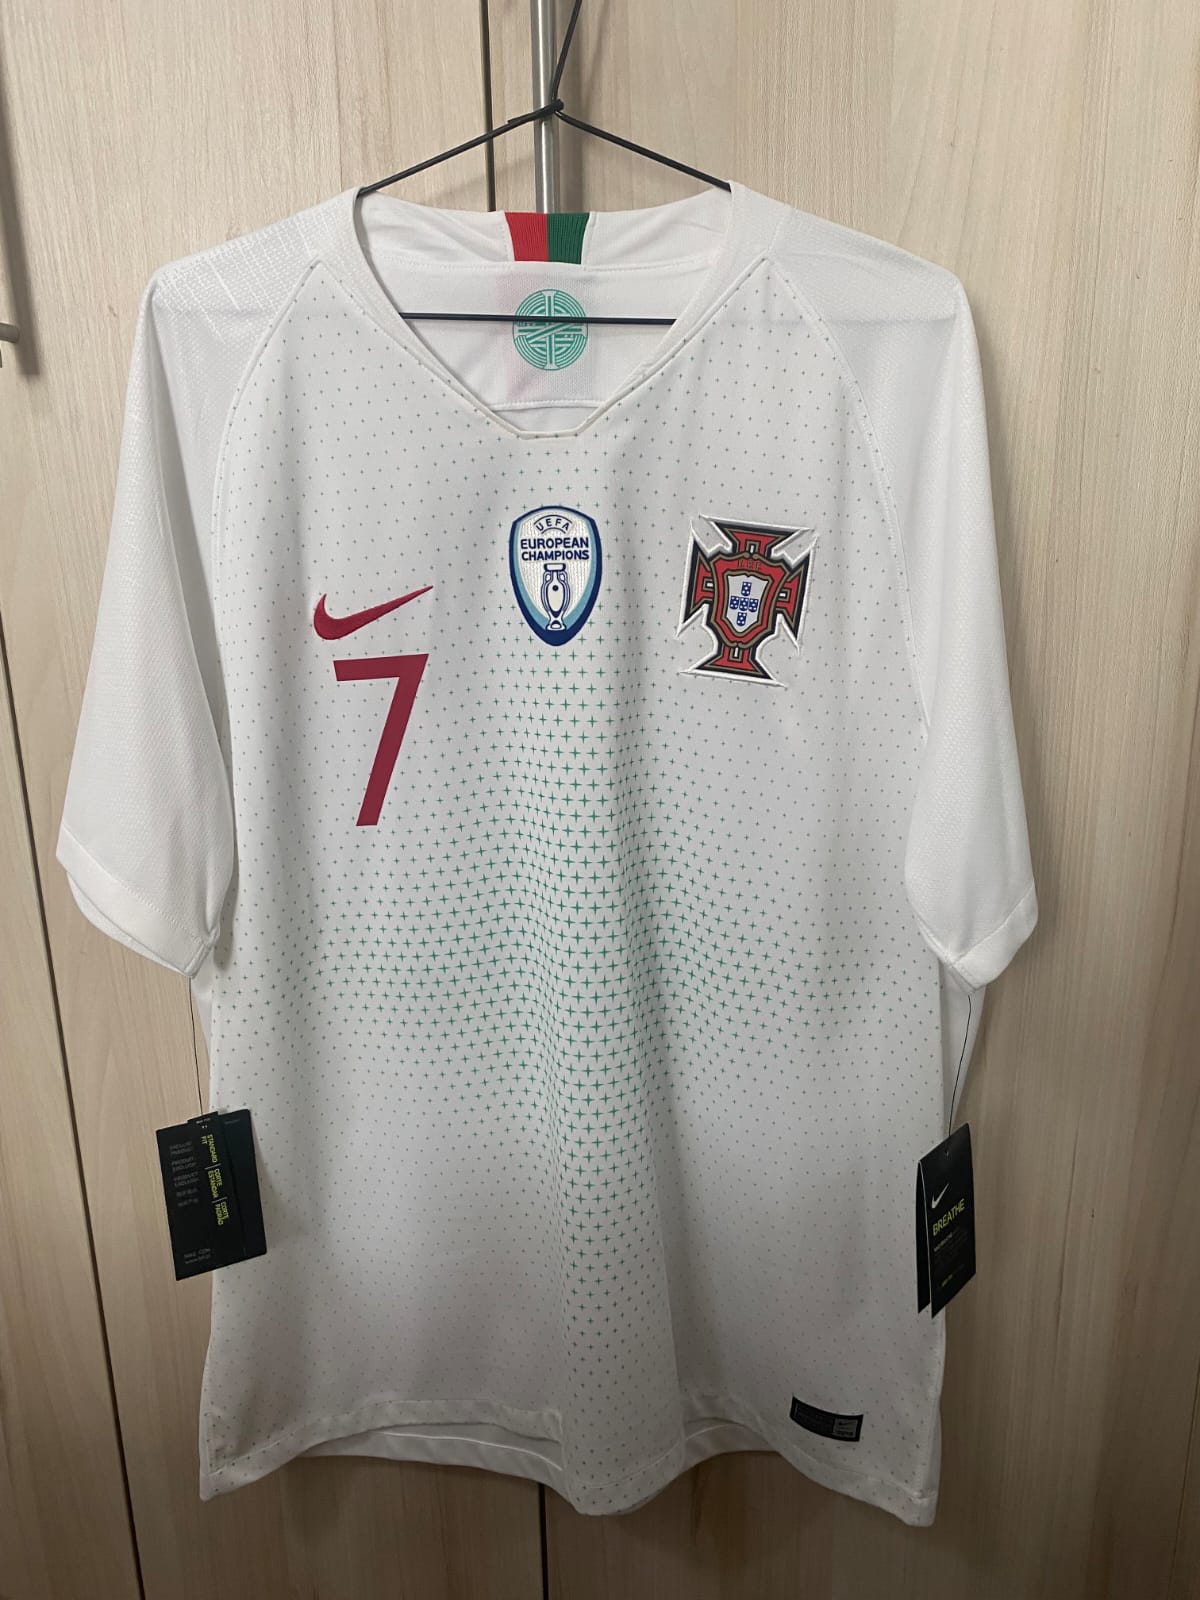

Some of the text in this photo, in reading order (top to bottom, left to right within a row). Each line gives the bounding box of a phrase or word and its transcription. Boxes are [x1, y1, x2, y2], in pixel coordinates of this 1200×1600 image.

[535, 518, 570, 531] UEFA
[520, 537, 589, 549] EUROPEAN
[521, 550, 590, 561] CHAMPIONS
[333, 653, 430, 826] 7
[932, 1198, 965, 1236] BREATHE
